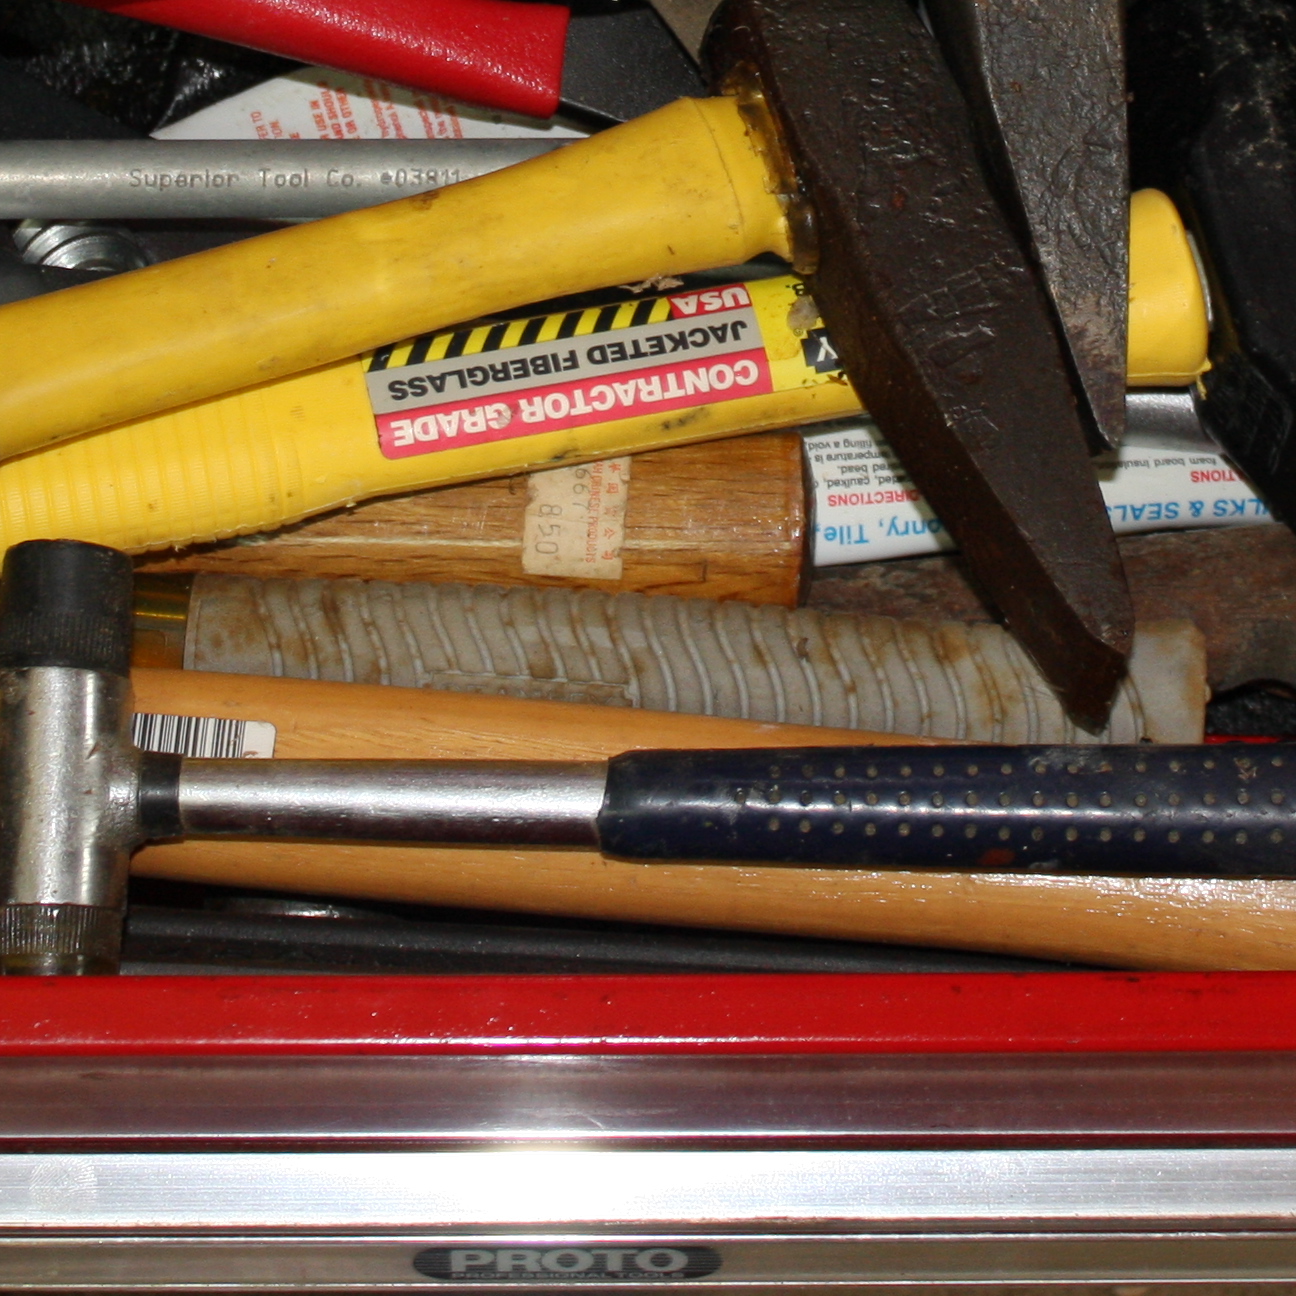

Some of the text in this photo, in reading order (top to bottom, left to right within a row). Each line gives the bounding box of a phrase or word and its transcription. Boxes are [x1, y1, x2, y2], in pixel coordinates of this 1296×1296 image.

[129, 168, 240, 192] Superior
[258, 167, 309, 188] Tool
[326, 168, 362, 188] Co.
[672, 286, 752, 316] USA
[586, 318, 749, 365] JACKETED
[387, 349, 579, 401] FIBERGLASS
[518, 359, 760, 424] CONTRACTOR
[393, 402, 514, 448] GRADE
[1191, 499, 1209, 519] &
[450, 1247, 688, 1274] PROTO
[451, 1271, 685, 1280] PROFESSIONAL TOOLS
